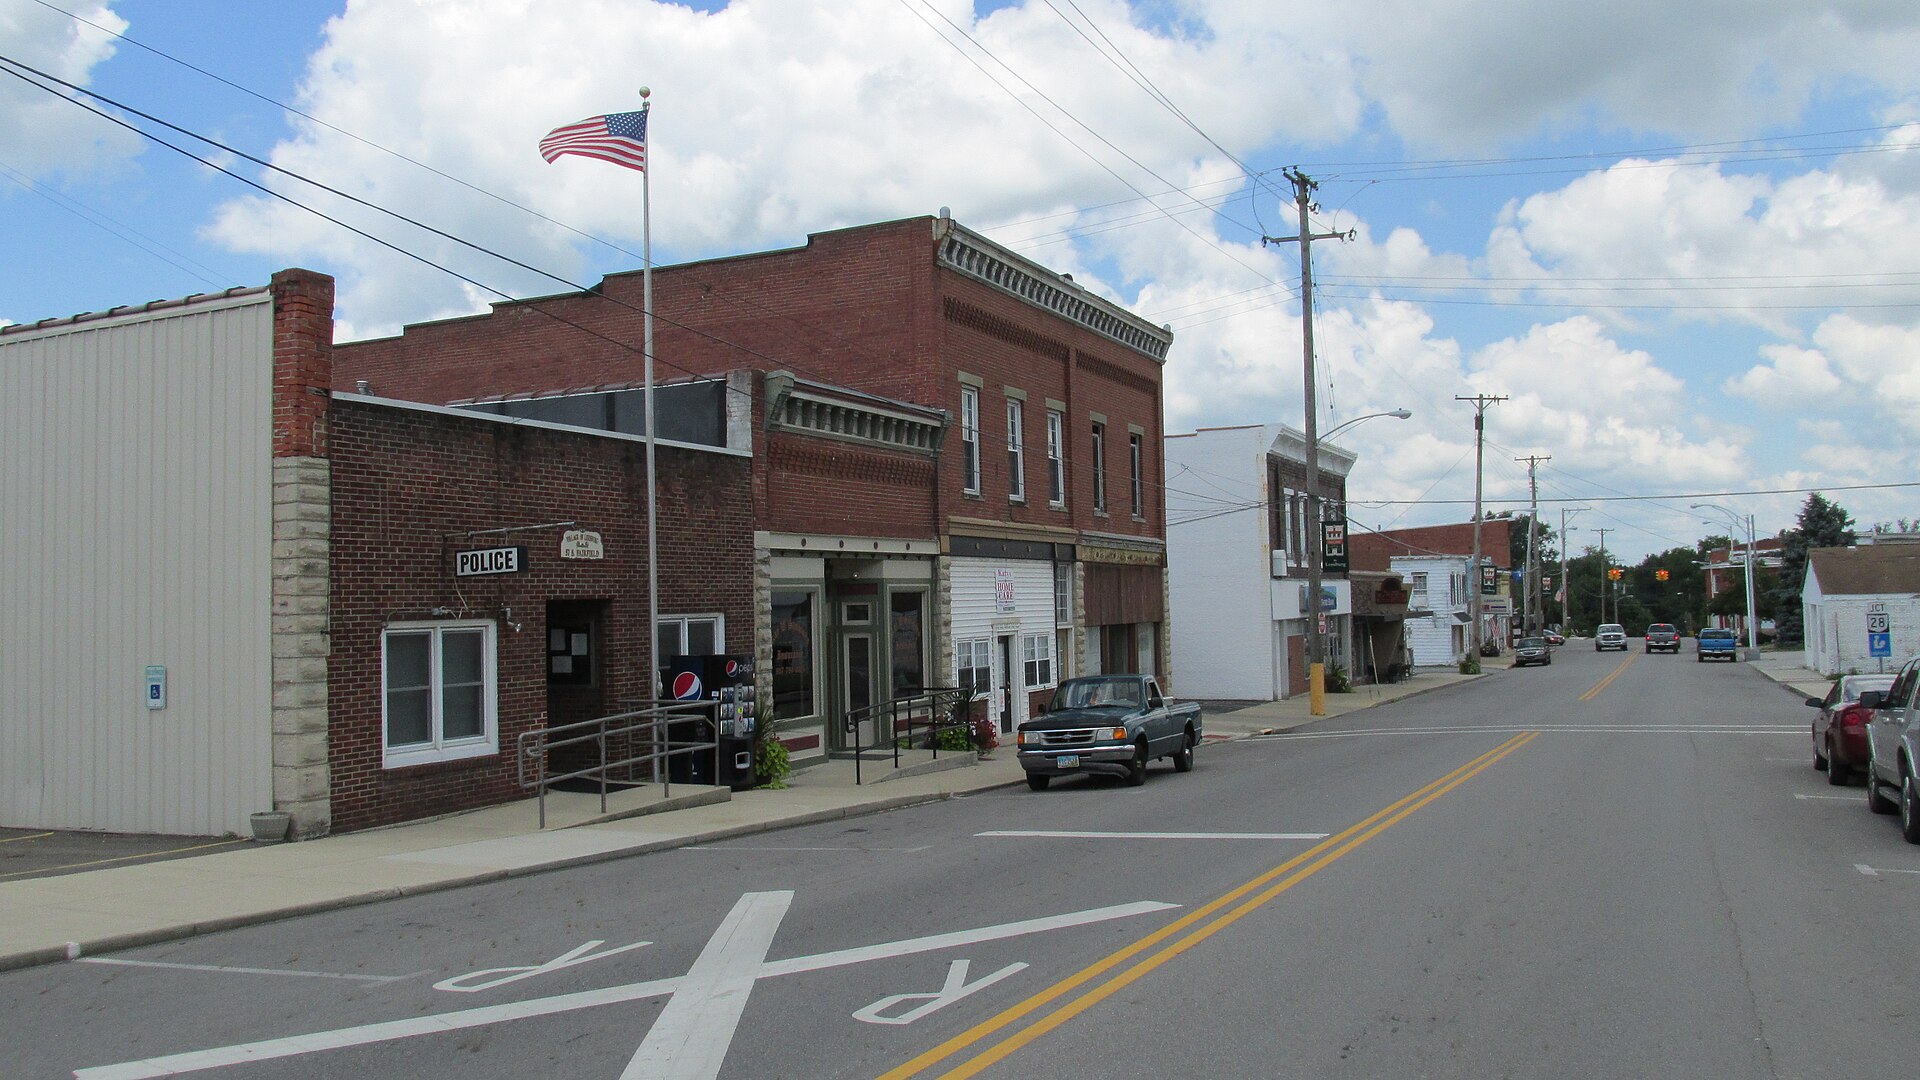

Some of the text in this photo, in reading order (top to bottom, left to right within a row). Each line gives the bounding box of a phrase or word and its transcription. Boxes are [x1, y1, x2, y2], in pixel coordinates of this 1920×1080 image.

[460, 550, 514, 573] POLICE
[997, 582, 1014, 592] HOME
[998, 591, 1014, 601] CARE
[1870, 603, 1885, 613] JCT
[1870, 617, 1885, 628] 28
